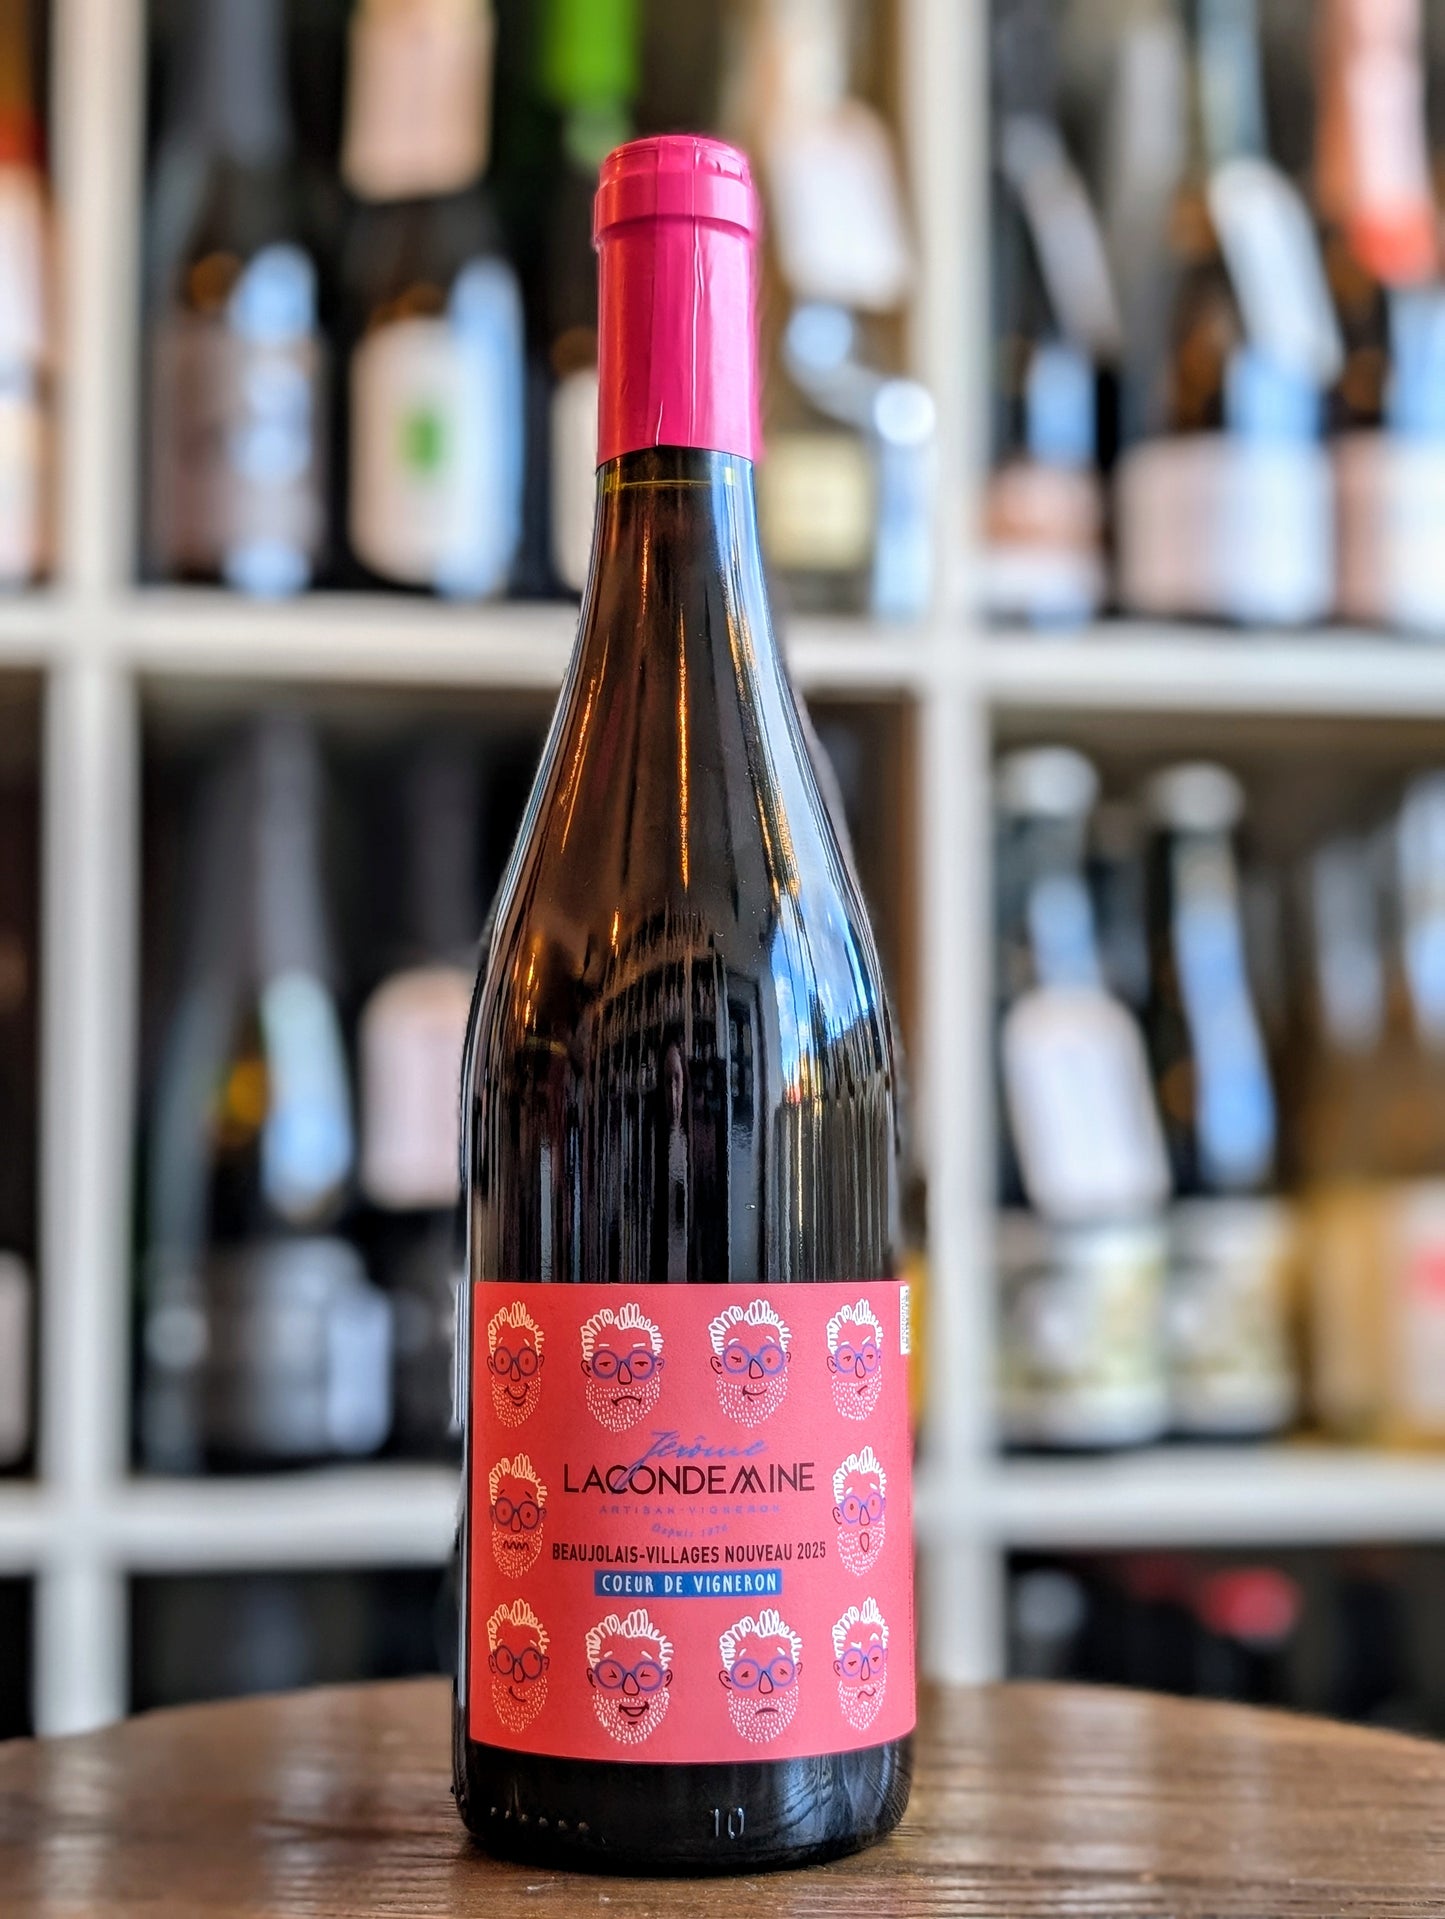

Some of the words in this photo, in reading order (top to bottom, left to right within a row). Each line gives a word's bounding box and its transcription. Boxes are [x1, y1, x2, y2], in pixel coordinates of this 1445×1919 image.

[613, 1430, 768, 1491] Jérôme
[563, 1462, 815, 1495] LACONDEMINE
[552, 1542, 719, 1564] BEAUJOLAIS-VILLAGES
[725, 1543, 793, 1563] NOUVEAU
[797, 1541, 826, 1560] 2025
[602, 1574, 654, 1593] COEUR
[664, 1574, 683, 1593] DE
[694, 1572, 777, 1593] VIGNERON
